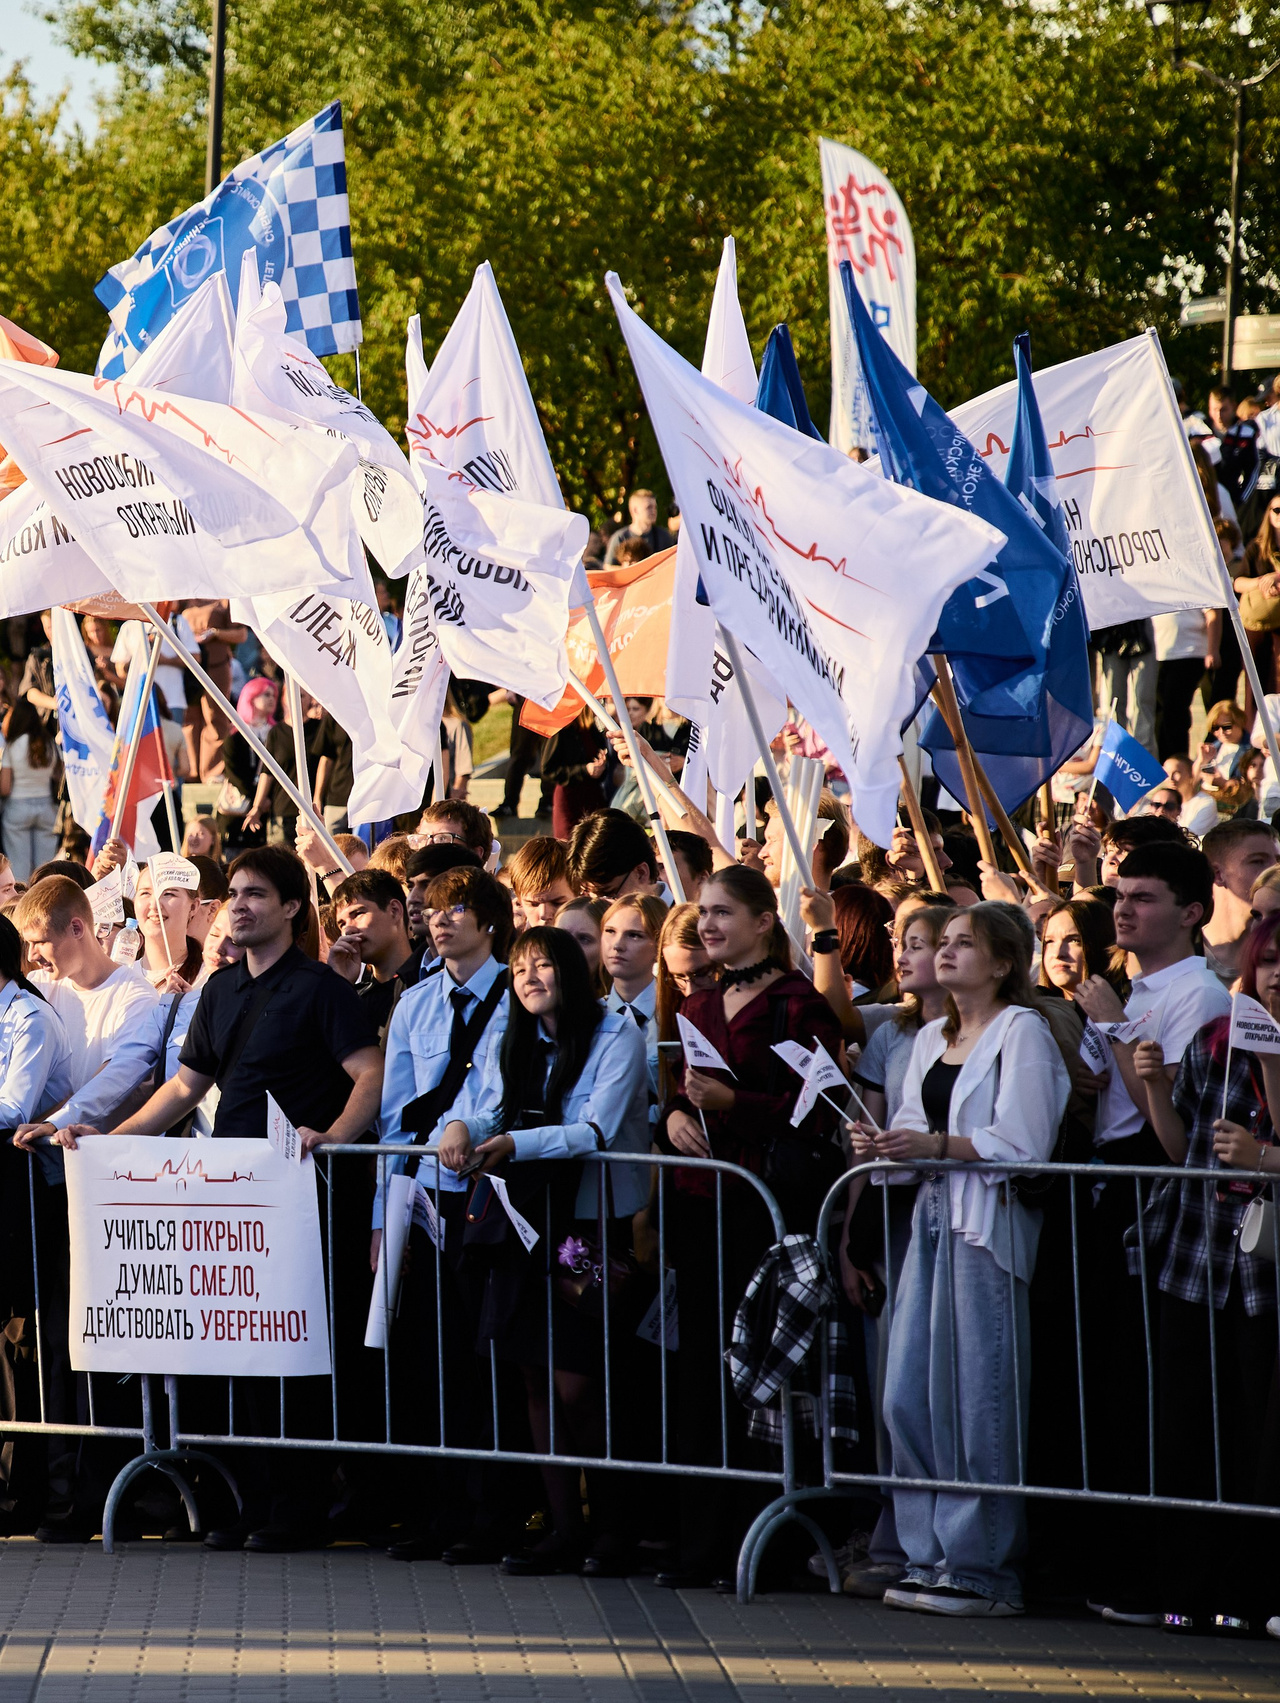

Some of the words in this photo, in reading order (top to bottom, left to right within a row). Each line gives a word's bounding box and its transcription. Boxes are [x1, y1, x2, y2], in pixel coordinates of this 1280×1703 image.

[1114, 753, 1152, 788] НГУЭУ
[103, 1218, 177, 1251] УЧИТЬСЯ
[181, 1219, 271, 1259] ОТКРЫТО,
[115, 1263, 184, 1301] ДУМАТЬ
[188, 1263, 261, 1303] СМЕЛО,
[82, 1299, 195, 1344] ДЕЙСТВОВАТЬ
[199, 1309, 309, 1343] УВЕРЕННО!
